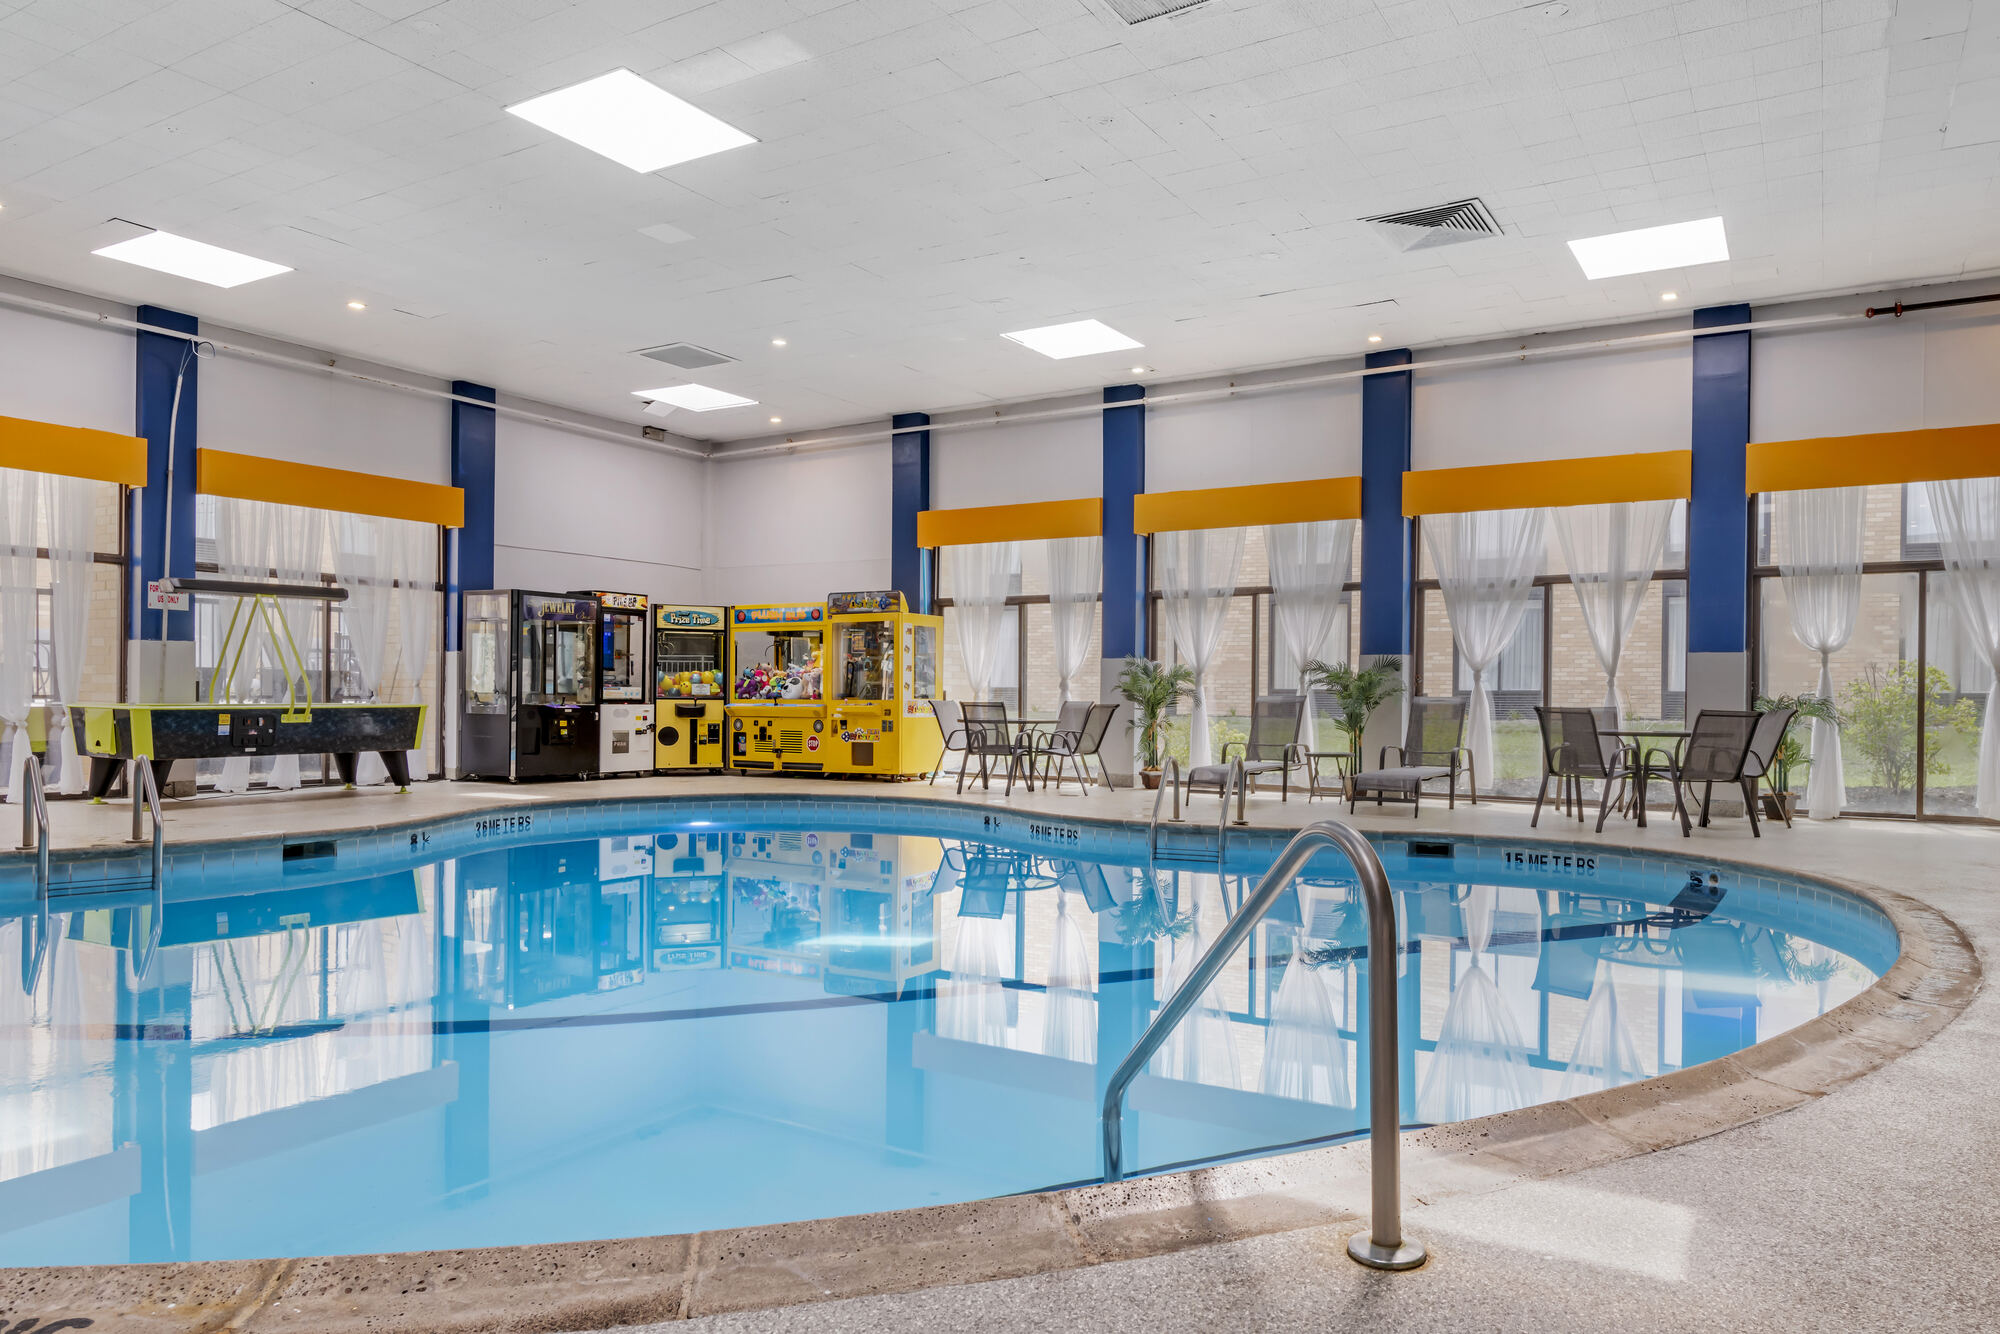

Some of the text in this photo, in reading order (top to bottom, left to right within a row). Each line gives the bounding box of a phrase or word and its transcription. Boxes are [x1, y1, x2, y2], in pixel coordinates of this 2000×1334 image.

[537, 601, 576, 618] JEWELRY
[751, 609, 807, 621] PLUSH BUS
[670, 612, 711, 625] Prize Time
[807, 739, 819, 748] STOP
[1528, 854, 1595, 869] METERS
